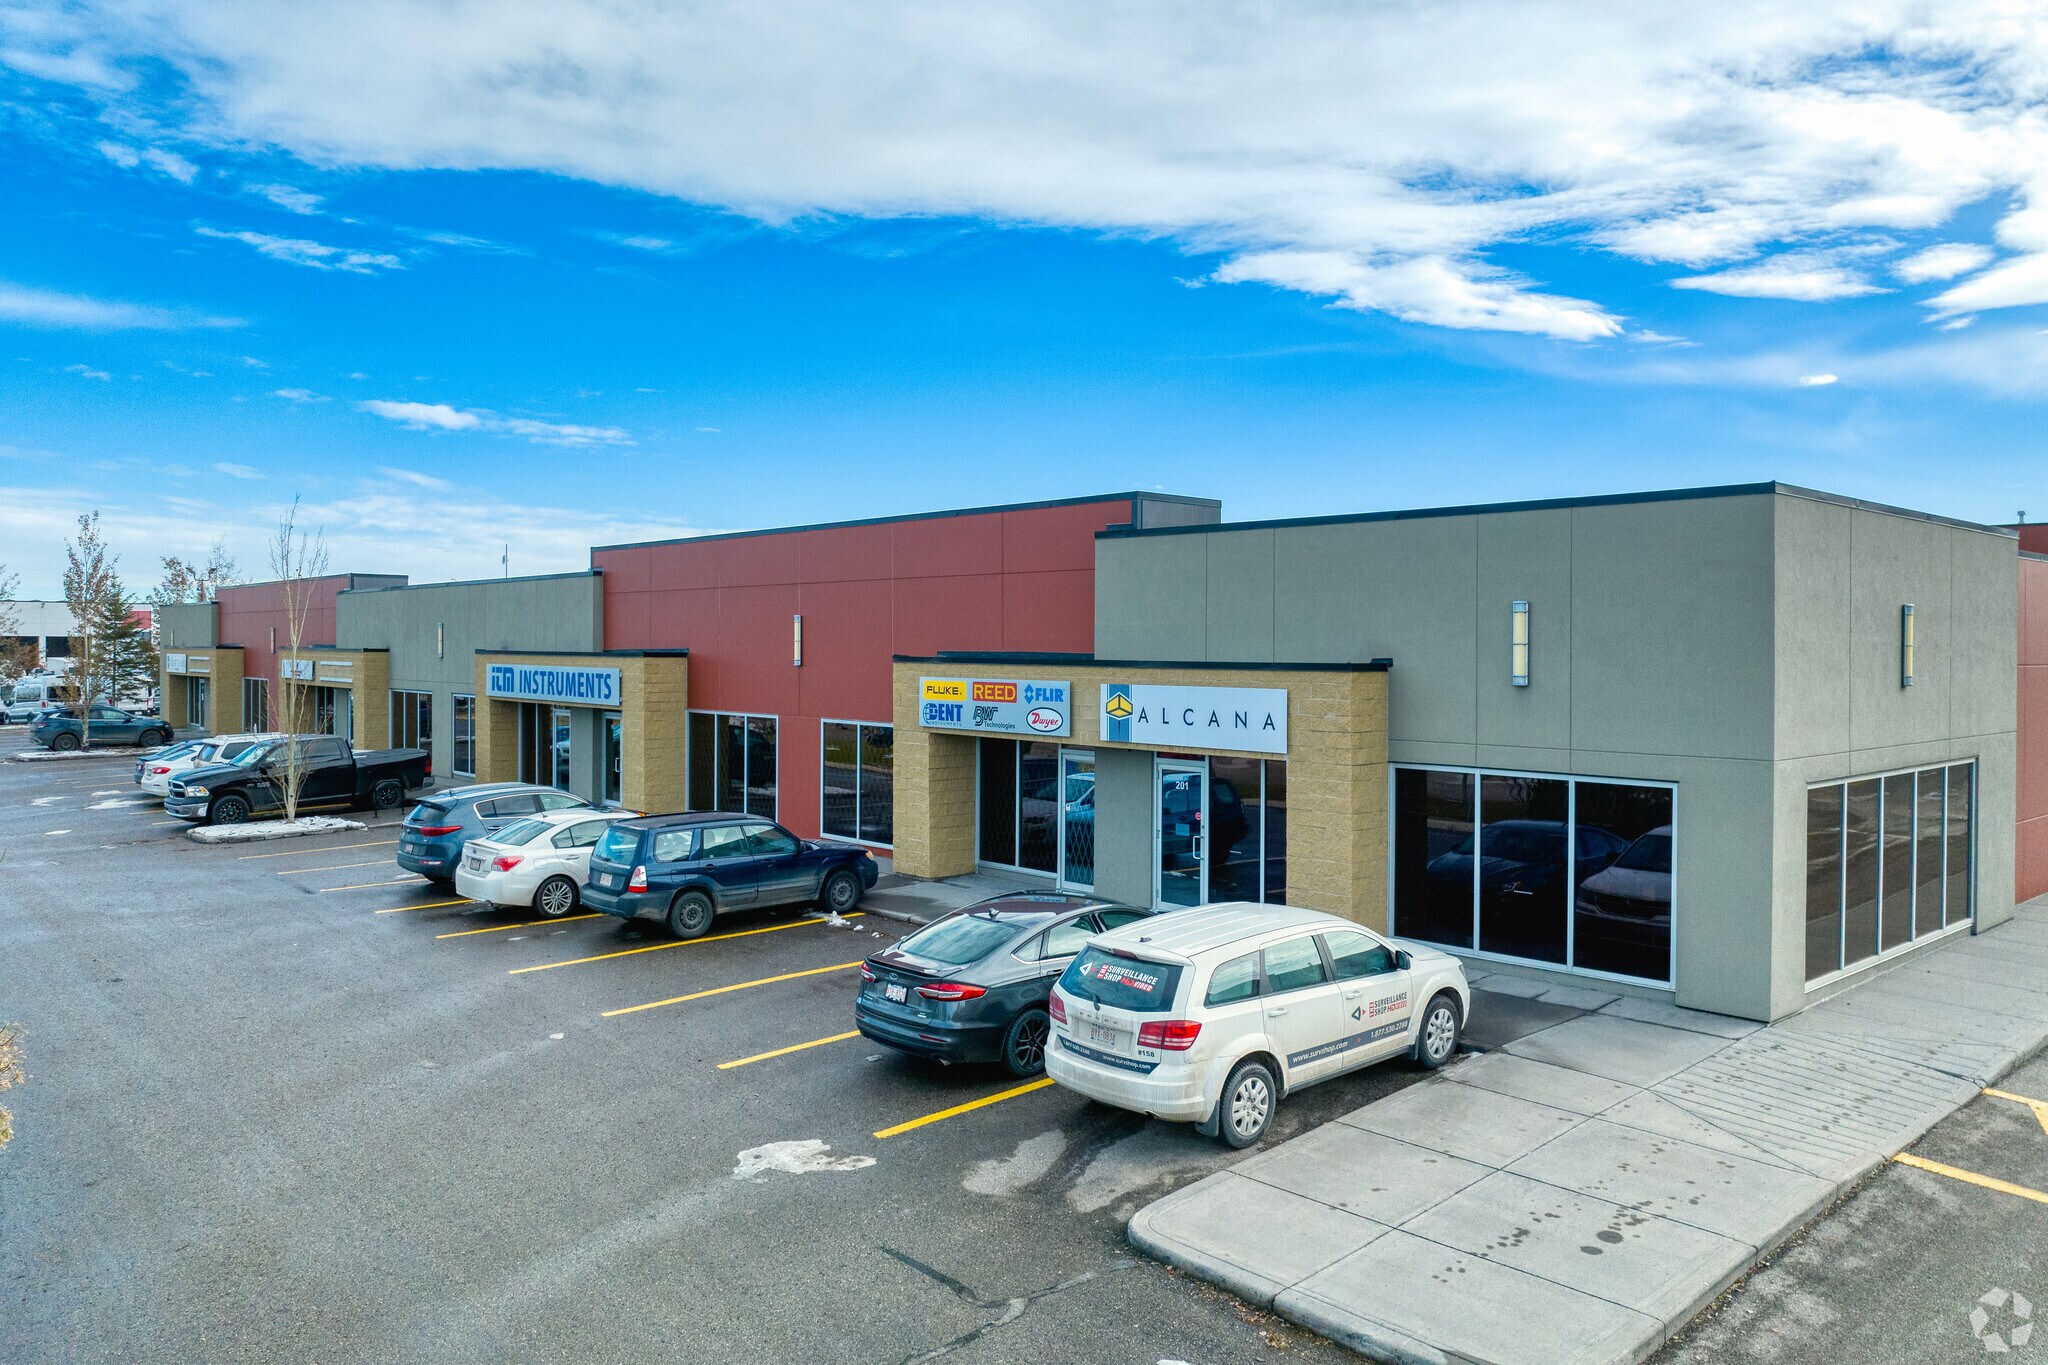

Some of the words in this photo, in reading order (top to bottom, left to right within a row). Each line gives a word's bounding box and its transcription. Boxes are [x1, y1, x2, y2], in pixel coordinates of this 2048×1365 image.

[519, 669, 612, 700] INSTRUMENTS
[973, 684, 1016, 701] REED
[1035, 687, 1064, 703] FLIR
[927, 703, 963, 722] DENT
[1031, 712, 1058, 728] Dwyer
[1137, 706, 1276, 731] ALCANA
[984, 721, 1016, 730] Technologies
[1175, 781, 1189, 791] 201
[1097, 964, 1109, 979] THE
[1103, 972, 1122, 983] SHOP
[1107, 965, 1158, 986] SURVEILLANCE
[1374, 991, 1408, 1008] SURVEILLANCE
[1374, 1005, 1387, 1016] SHOP
[1137, 1049, 1155, 1058] #158
[1292, 1040, 1348, 1063] www.survshop.com
